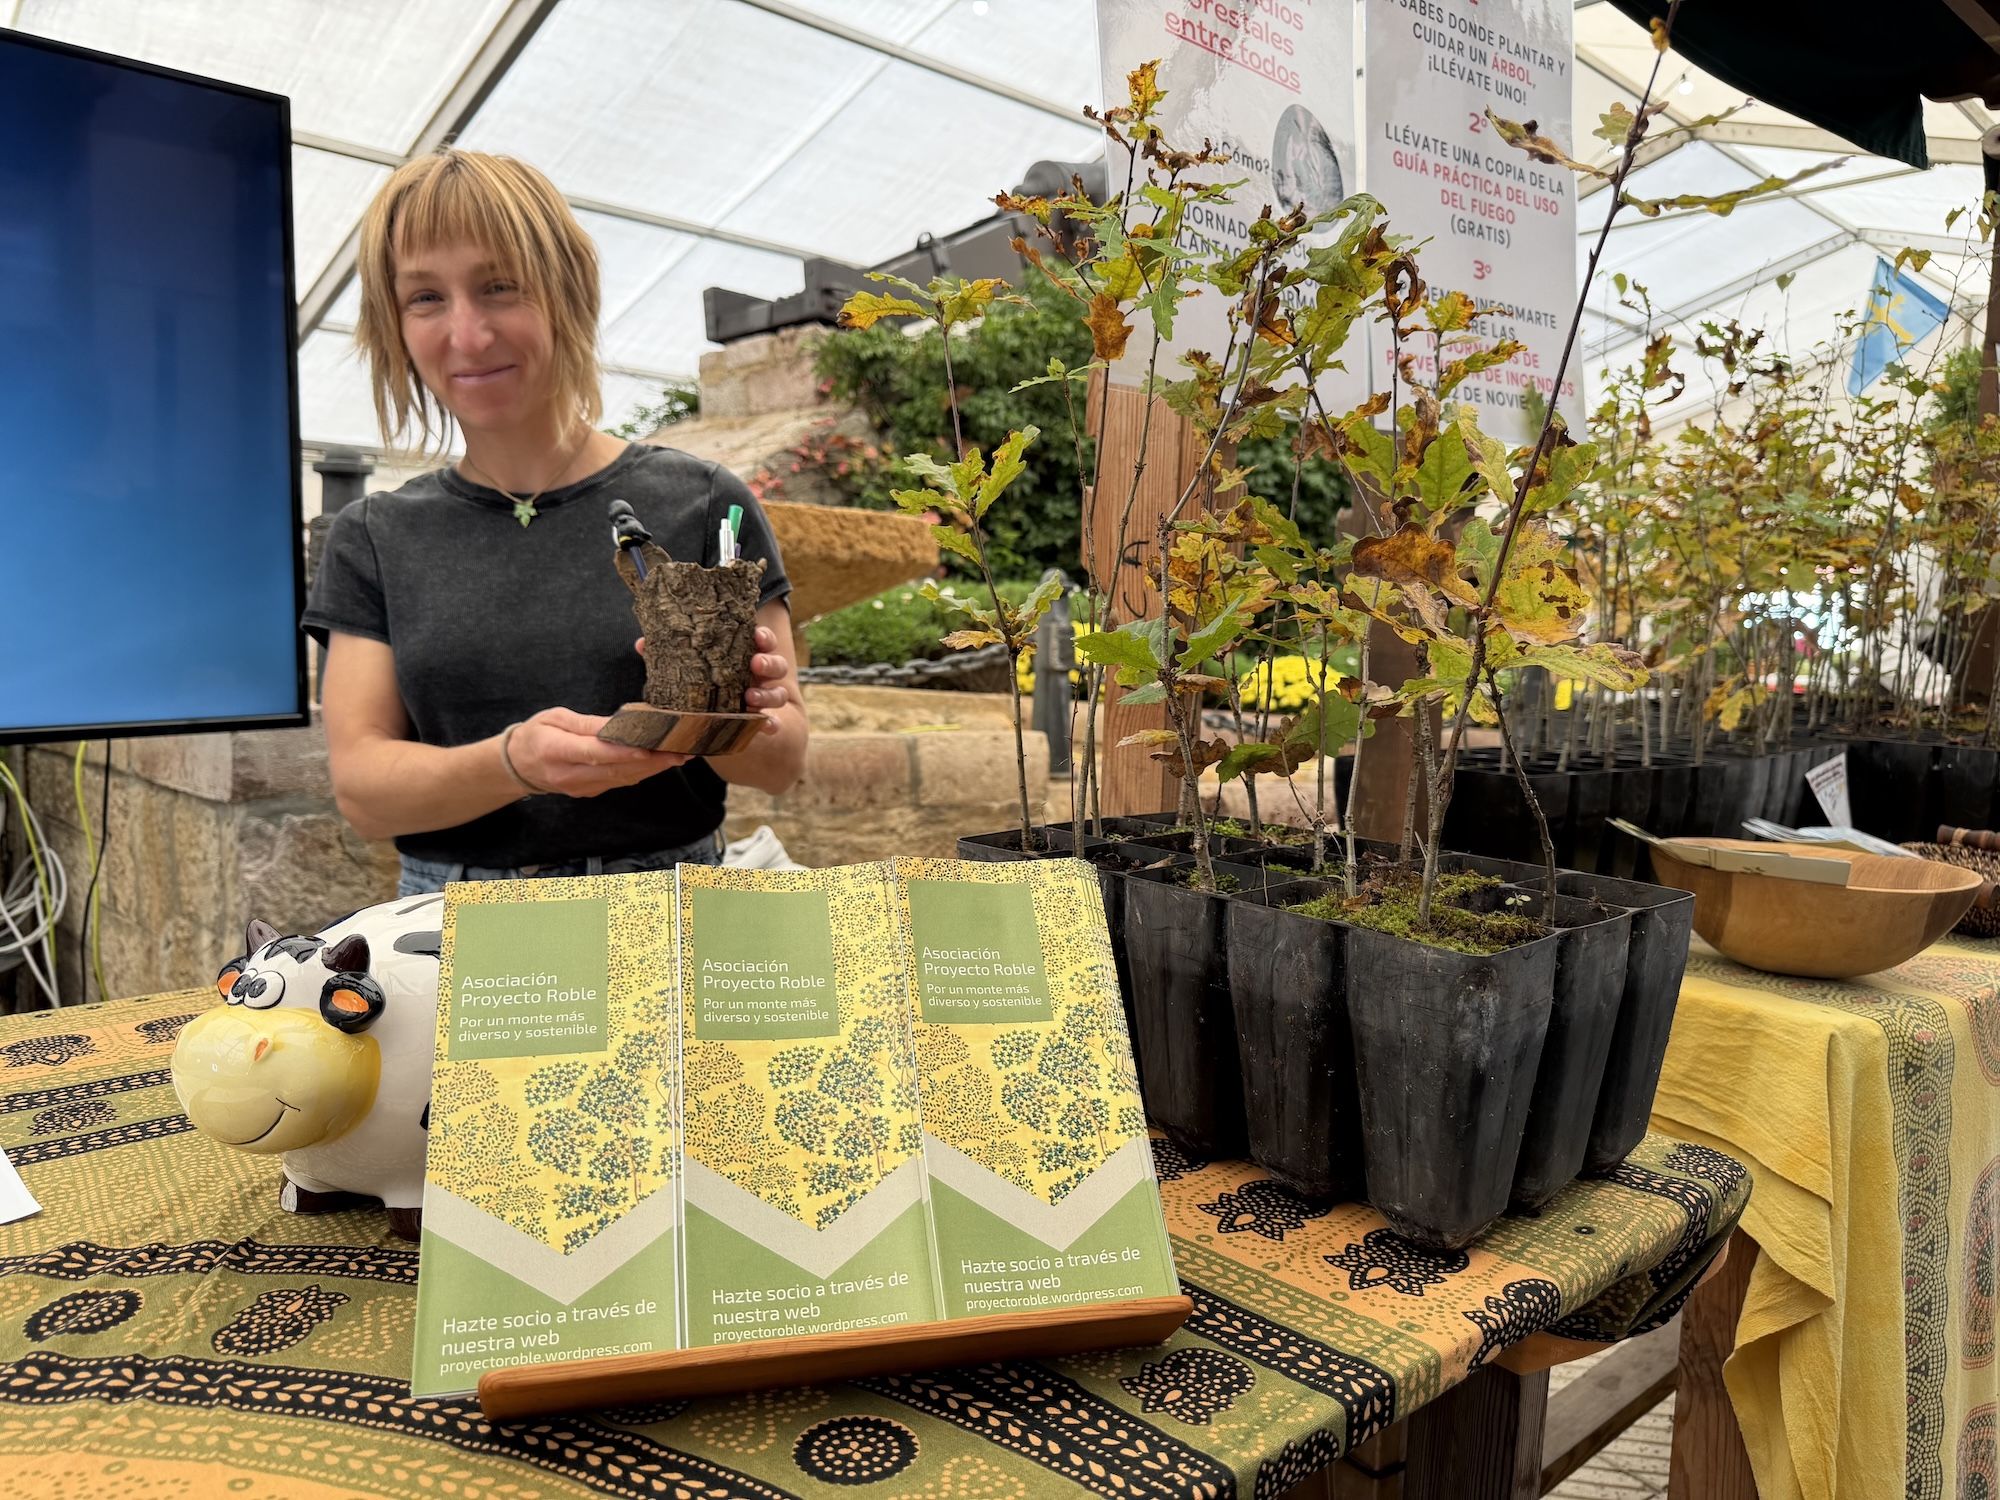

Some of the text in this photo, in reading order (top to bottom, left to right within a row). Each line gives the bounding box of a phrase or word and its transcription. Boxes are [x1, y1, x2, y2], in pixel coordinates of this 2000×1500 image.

[1165, 12, 1301, 89] entre todos
[1413, 22, 1537, 89] CUIDAR UN ÁRBOL,
[1449, 13, 1494, 46] DONDE
[1499, 35, 1555, 73] PLANTAR
[1558, 60, 1566, 77] Y
[1428, 54, 1527, 106] ¡LLÉVATE UNO!
[1385, 122, 1564, 196] LLÉVATE UNA COPIA DE LA
[1393, 150, 1558, 216] GUÍA PRÁCTICA DEL USO
[1440, 189, 1516, 225] DEL FUEGO
[1183, 204, 1247, 239] JORNAD
[1451, 213, 1511, 248] (GRATIS)
[1491, 323, 1516, 341] LAS
[1523, 353, 1540, 369] DE
[1463, 386, 1482, 403] DE
[1484, 367, 1574, 397] DE INCNDOS
[702, 958, 788, 973] Asociación
[922, 946, 1000, 960] Asociación
[462, 972, 558, 990] Asociación
[924, 962, 1036, 978] Proyecto Roble
[703, 975, 826, 992] Proyecto Roble
[926, 983, 1030, 995] Por un monte más
[461, 987, 597, 1009] Proyecto Roble
[703, 997, 817, 1009] Por un monte más
[928, 996, 1042, 1010] diverso y sostenible
[459, 1010, 585, 1028] Por un monte más
[703, 1010, 829, 1025] diverso y sostenible
[459, 1024, 598, 1041] diverso y sostenible
[961, 1247, 1141, 1274] Hazte socio a través de
[712, 1271, 909, 1305] Hazte socio a través de
[964, 1273, 1061, 1294] nuestra web
[966, 1284, 1144, 1312] proyectoroble.wordpress.com
[443, 1299, 657, 1335] Hazte socio a través de
[713, 1302, 821, 1325] nuestra web
[713, 1311, 909, 1344] proyectoroble.wordpress.com
[441, 1329, 560, 1356] nuestra web
[440, 1340, 653, 1376] proyectoroble.wordpress.com
